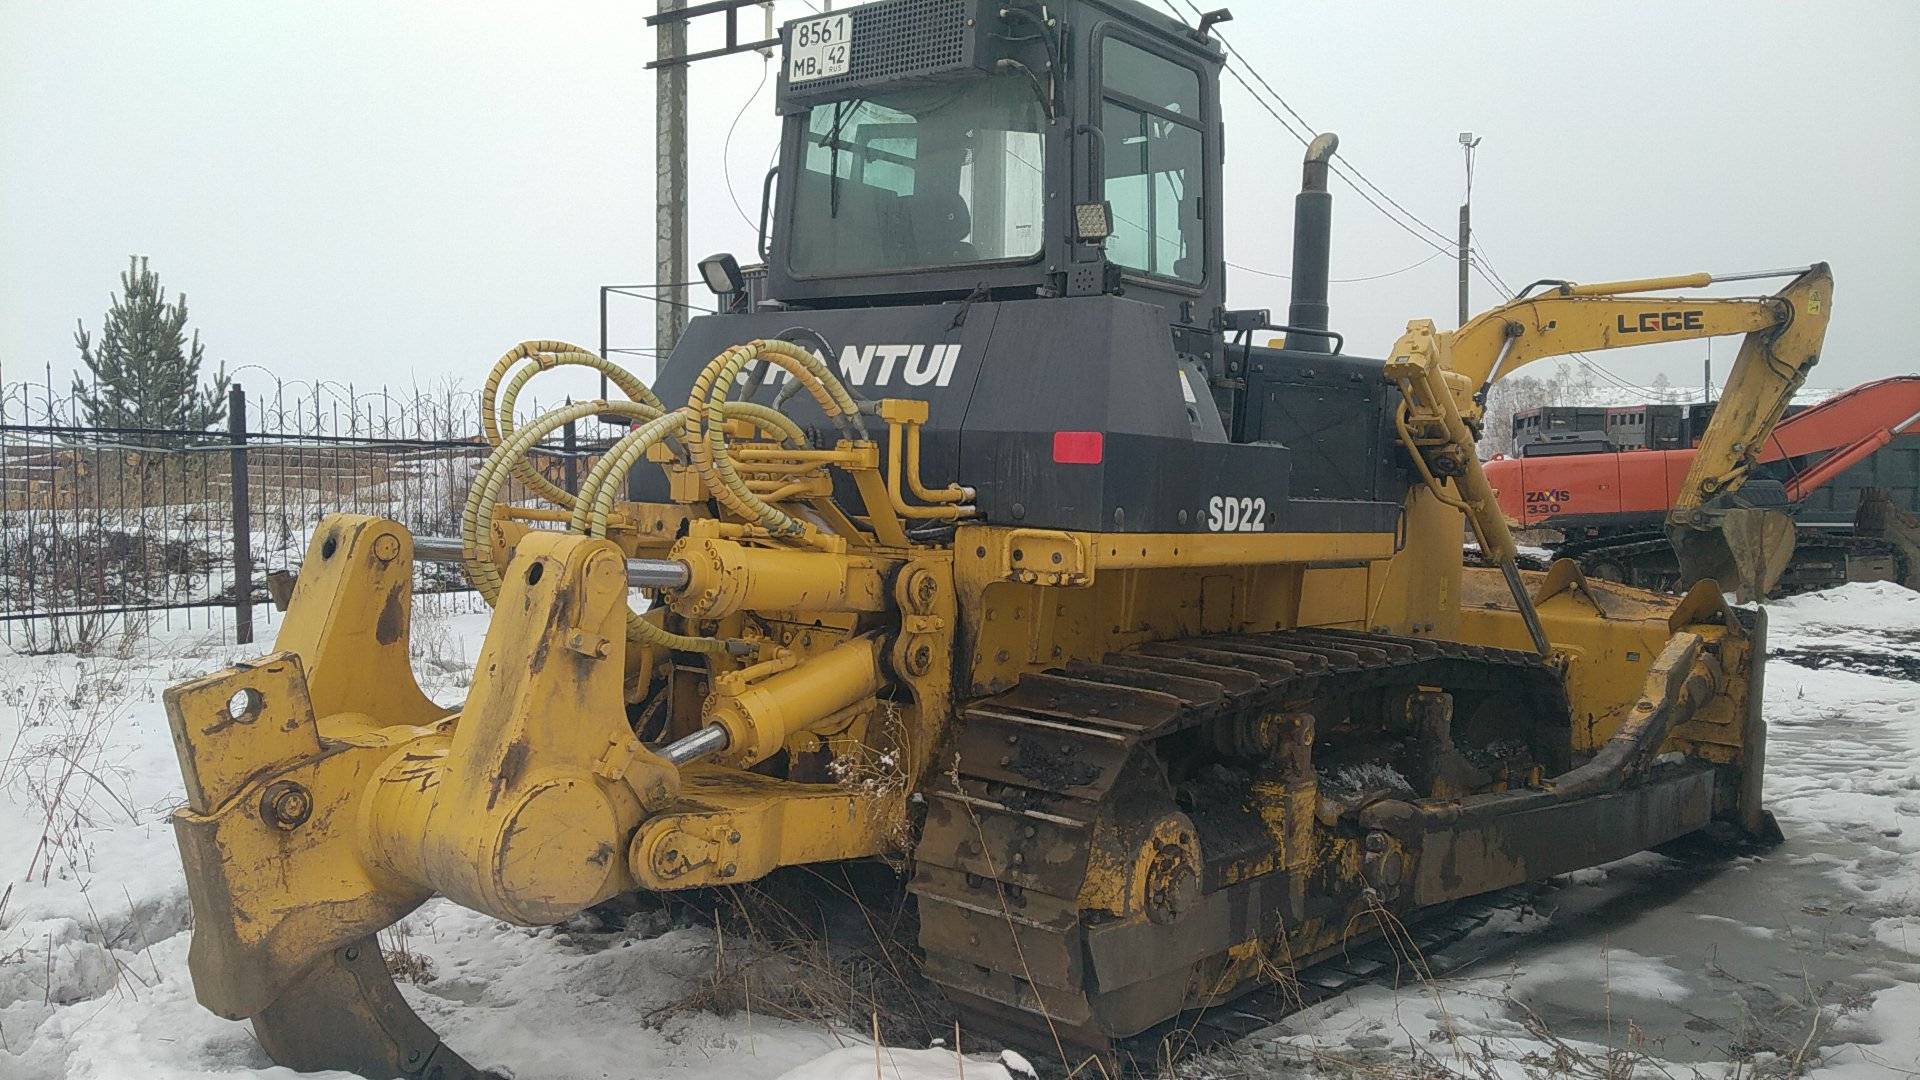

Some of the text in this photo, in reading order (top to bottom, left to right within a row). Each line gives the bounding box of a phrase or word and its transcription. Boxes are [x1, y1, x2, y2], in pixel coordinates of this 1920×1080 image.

[799, 16, 844, 48] 8561
[828, 46, 845, 64] 42
[1617, 310, 1705, 334] LGCE
[1526, 489, 1570, 503] ZAXIS
[1208, 495, 1266, 532] SD22
[1526, 503, 1561, 514] 330
